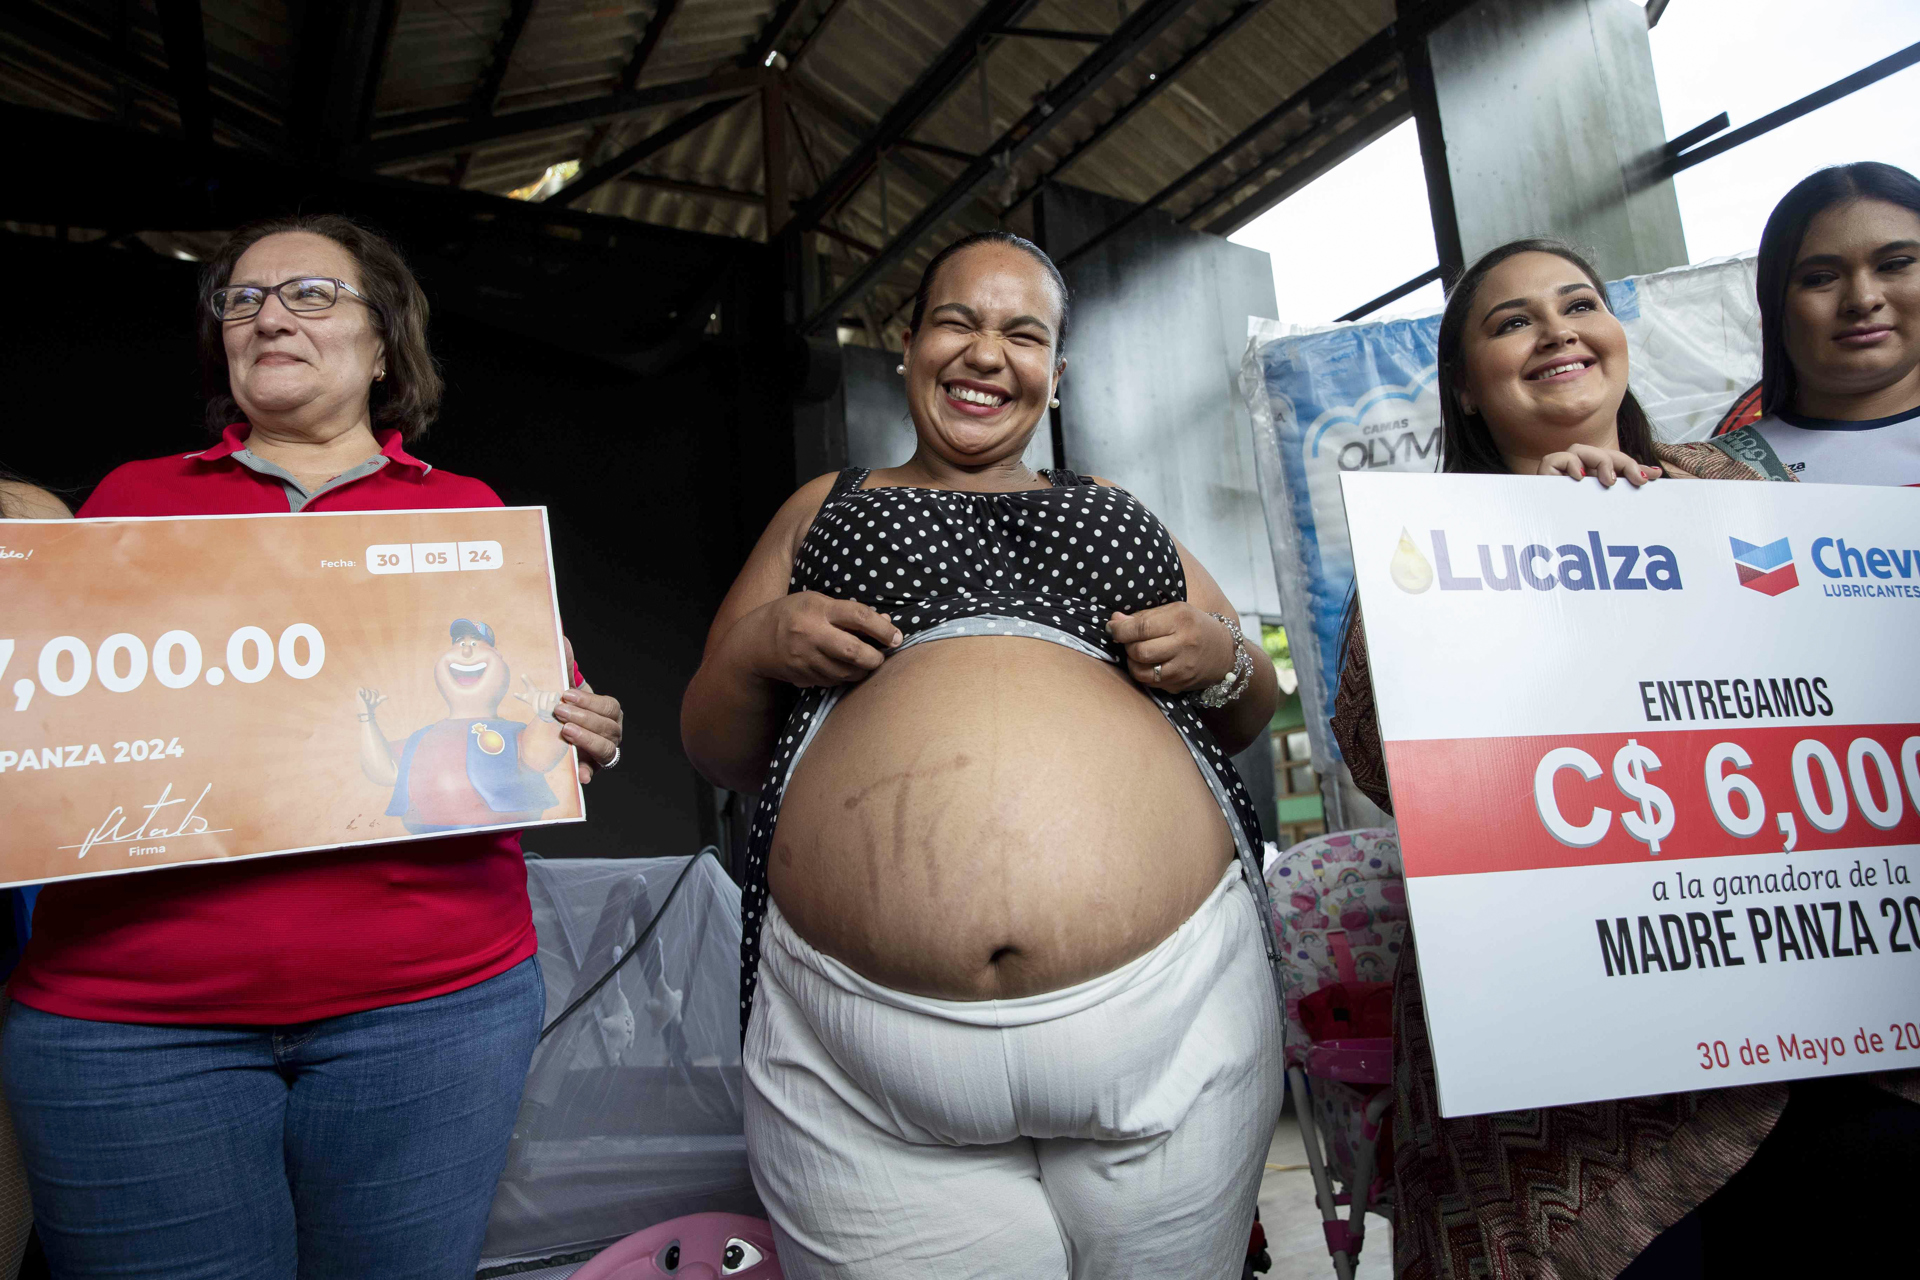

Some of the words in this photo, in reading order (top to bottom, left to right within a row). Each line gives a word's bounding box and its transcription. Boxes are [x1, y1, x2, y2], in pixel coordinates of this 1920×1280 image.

[1363, 418, 1409, 435] CAMAS
[320, 559, 357, 568] Fecha:
[376, 553, 400, 567] 30
[425, 552, 448, 565] 05
[468, 550, 491, 563] 24
[1429, 528, 1684, 592] Lucalza
[1822, 584, 1920, 598] LUBRICANTES
[1638, 676, 1834, 722] ENTREGAMOS
[0, 744, 107, 773] PANZA
[113, 737, 185, 763] 2024
[1534, 739, 1676, 855] C$
[128, 844, 166, 857] Firma
[1652, 878, 1671, 901] a
[1676, 872, 1705, 899] la
[1712, 864, 1841, 905] ganadora
[1849, 860, 1878, 887] de
[1883, 858, 1911, 885] la
[1595, 909, 1746, 977] MADRE
[1746, 900, 1880, 964] PANZA
[1696, 1040, 1730, 1070] 30
[1739, 1038, 1770, 1066] de
[1776, 1033, 1846, 1066] Mayo
[1853, 1027, 1884, 1055] de
[1889, 1022, 1920, 1051] 20
